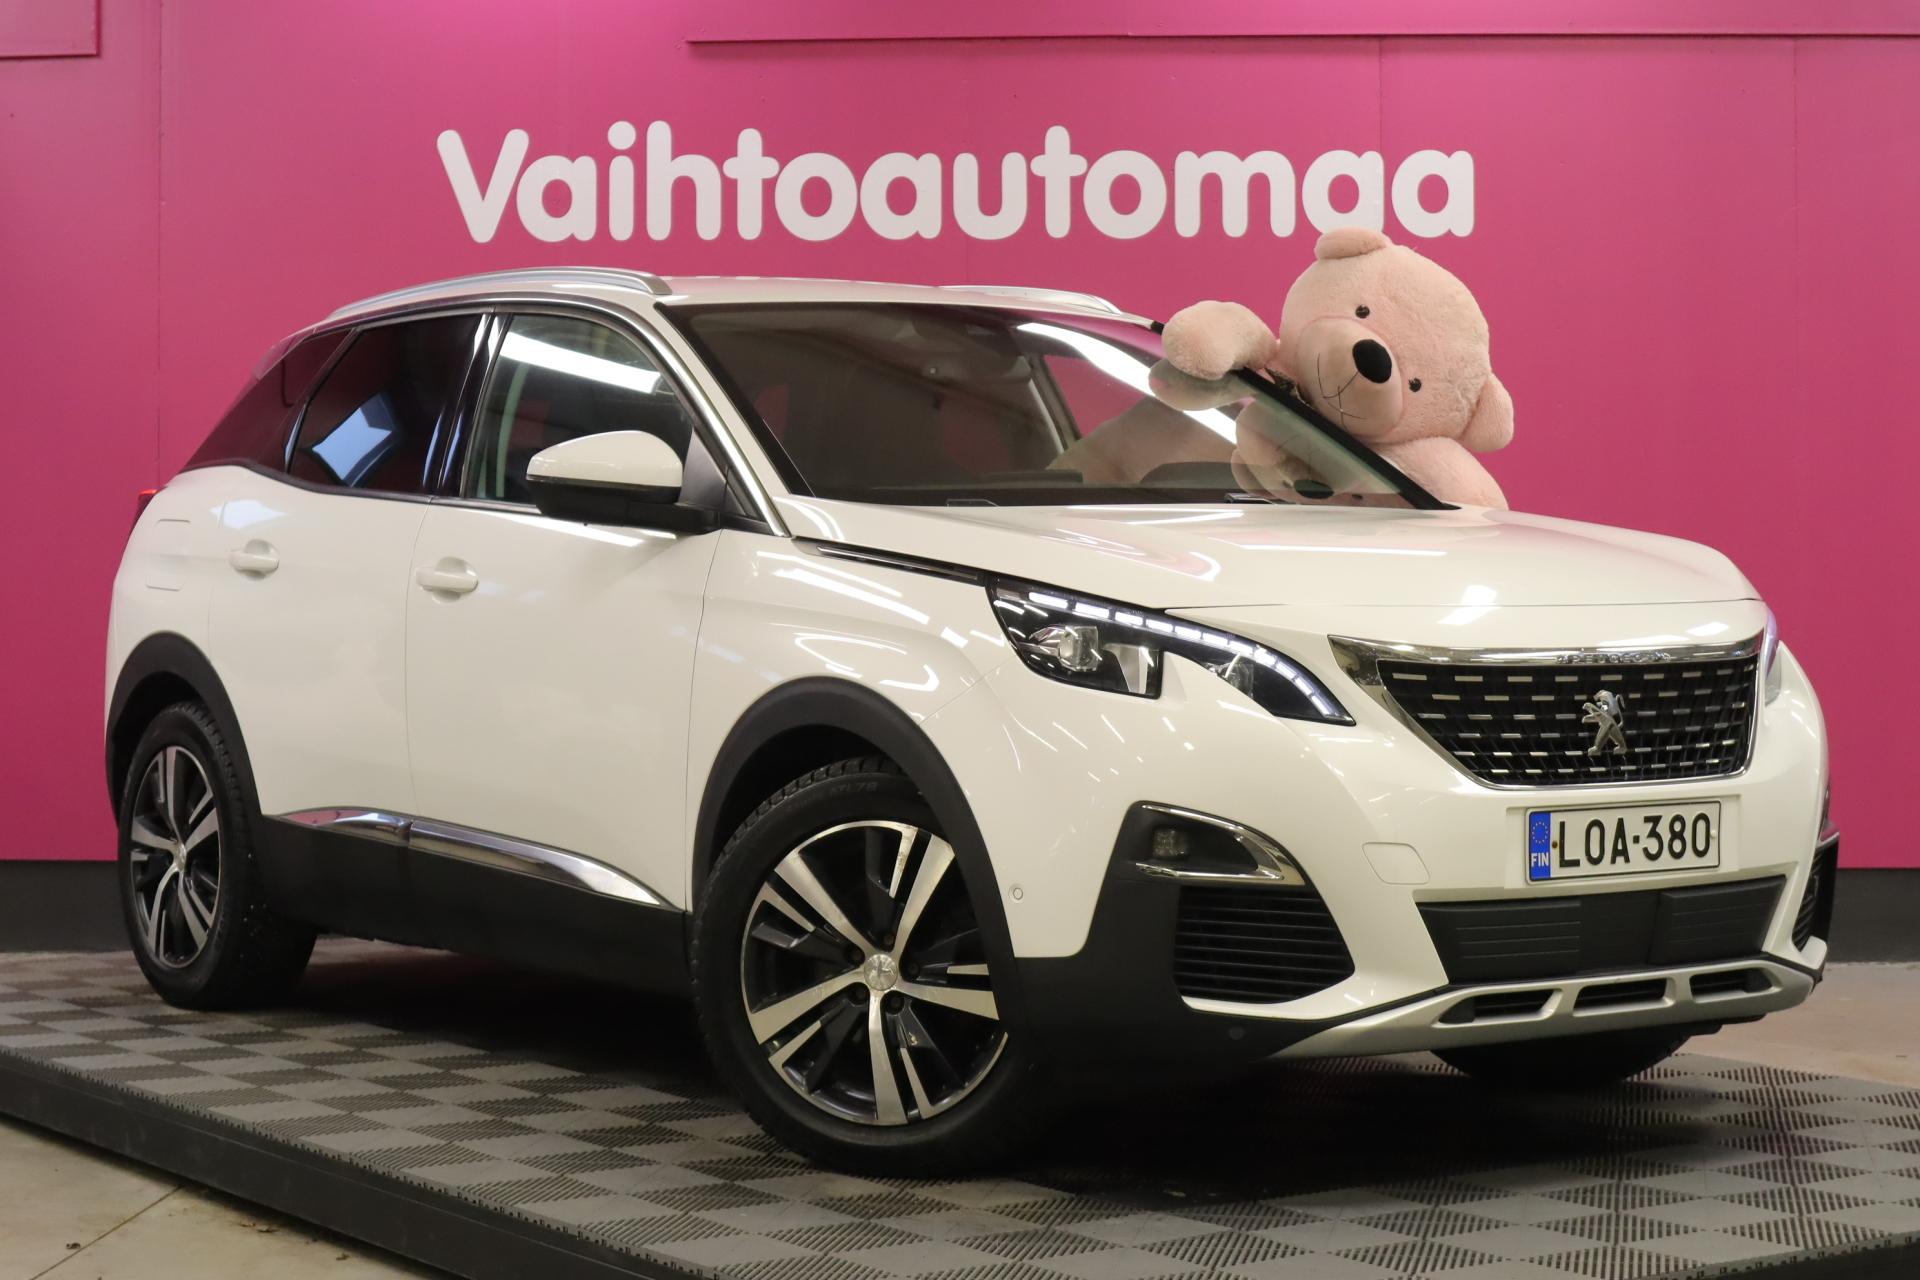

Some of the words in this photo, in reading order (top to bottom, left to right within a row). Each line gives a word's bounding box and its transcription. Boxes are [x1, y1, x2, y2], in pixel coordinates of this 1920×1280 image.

[437, 120, 1475, 243] Vaihtoautomaa
[1530, 852, 1549, 867] FIN
[1559, 812, 1711, 868] LOA-380
